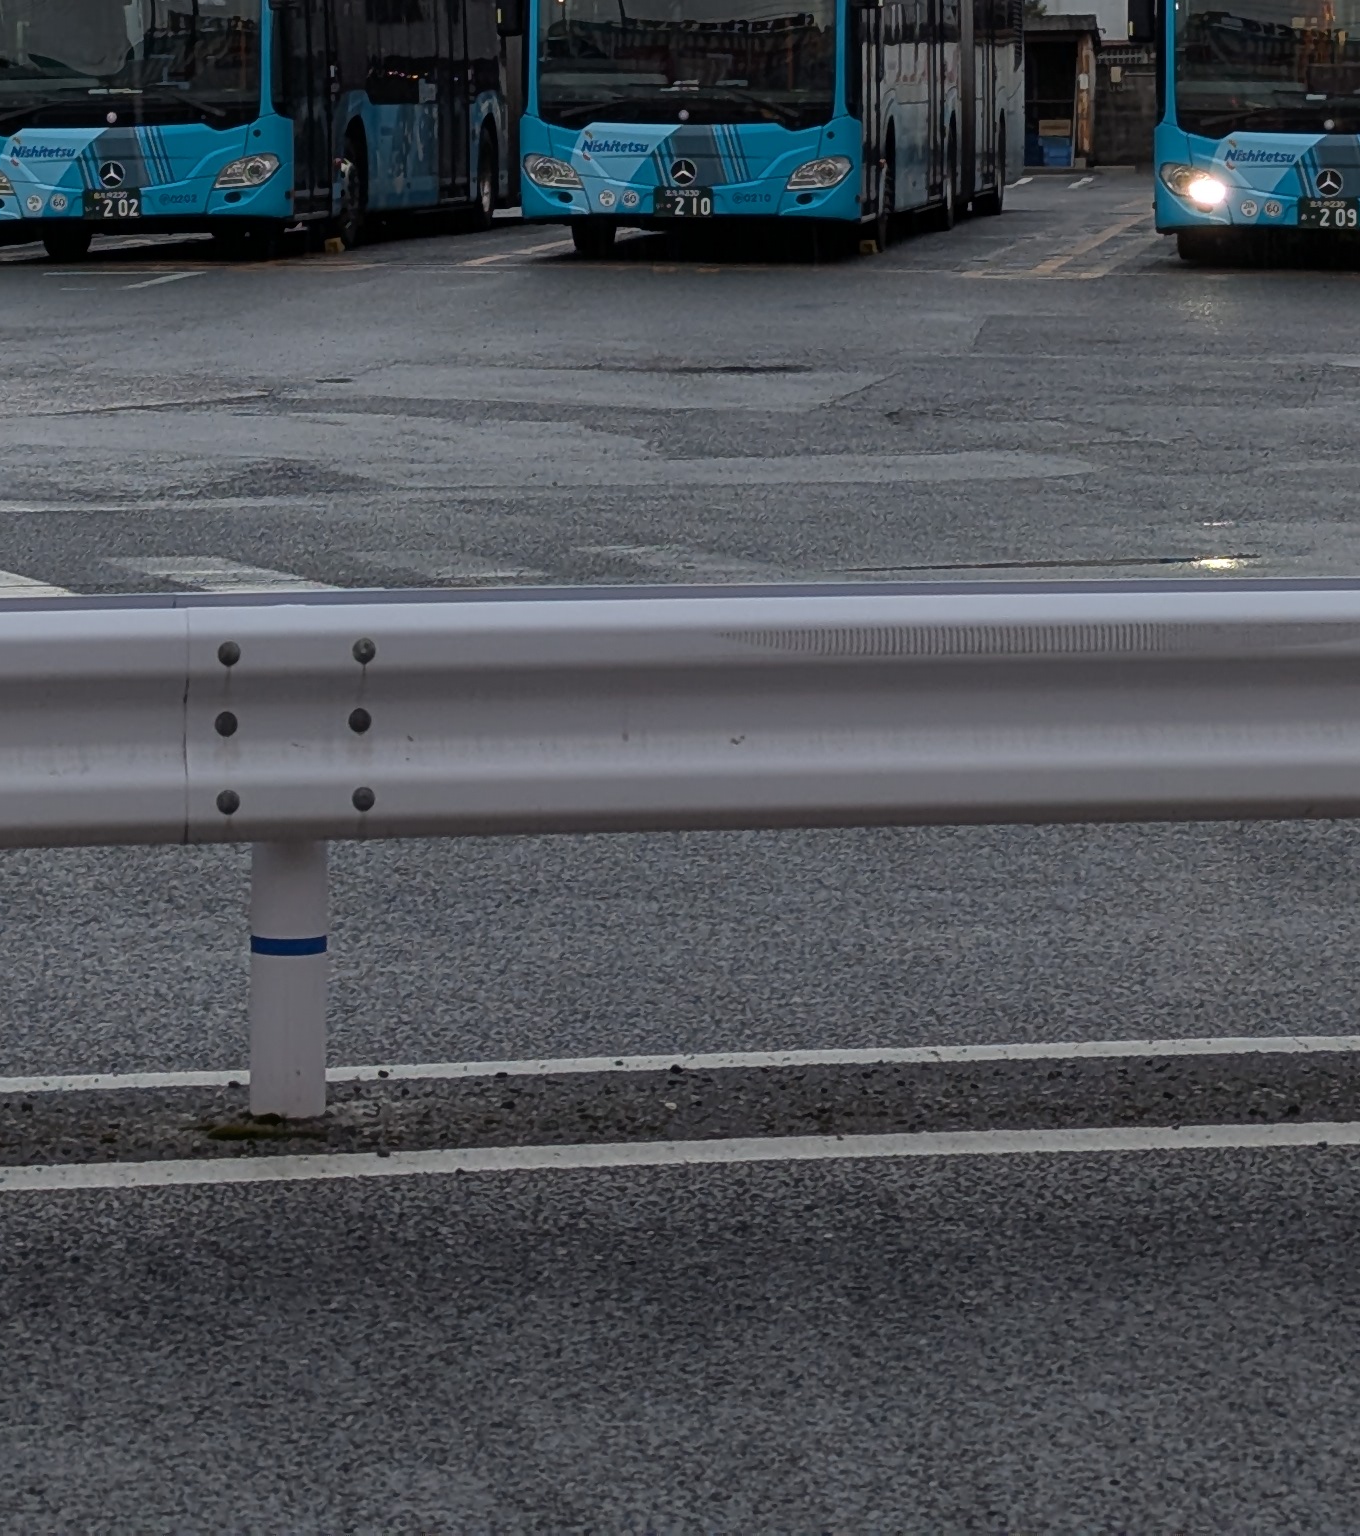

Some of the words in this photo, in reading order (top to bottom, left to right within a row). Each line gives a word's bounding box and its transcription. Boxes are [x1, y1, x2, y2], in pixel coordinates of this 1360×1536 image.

[10, 145, 76, 158] Nishitetsu
[581, 139, 650, 153] Nishitetsu
[1224, 149, 1296, 163] Nishitetsu
